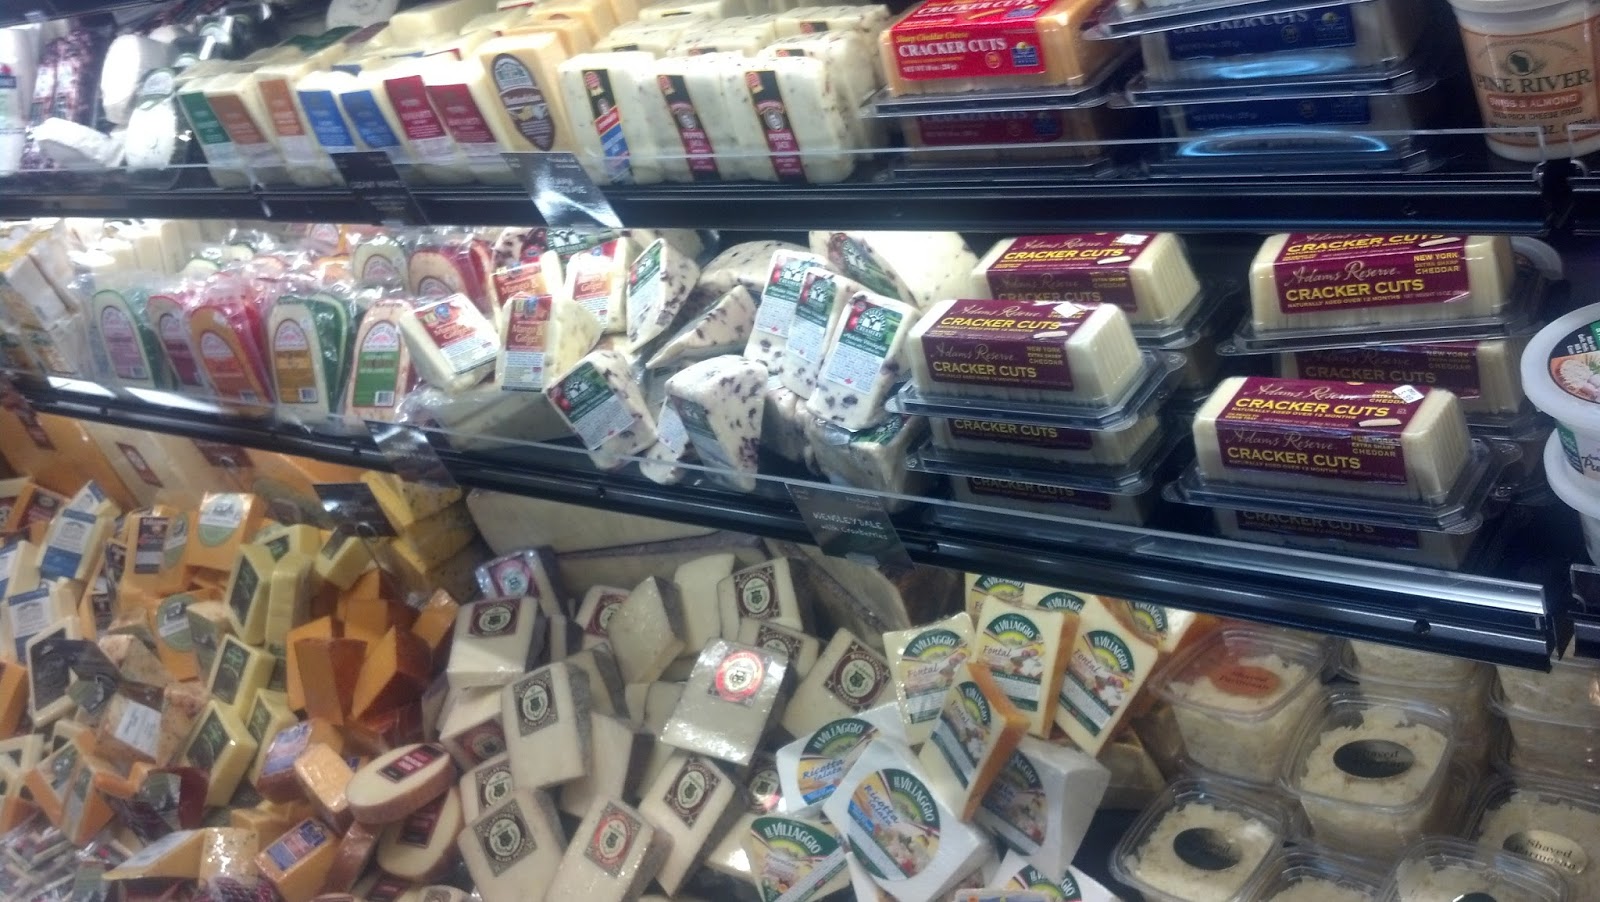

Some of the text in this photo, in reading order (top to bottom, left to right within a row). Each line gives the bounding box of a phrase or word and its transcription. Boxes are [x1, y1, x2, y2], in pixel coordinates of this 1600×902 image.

[899, 38, 1008, 57] CRACKER CUTS
[1521, 69, 1592, 93] RIVER
[1530, 94, 1578, 107] ALMOND
[1004, 249, 1079, 260] CRACKER
[1080, 248, 1126, 257] CUTS
[1288, 237, 1384, 253] CRACKER
[1414, 252, 1458, 262] NEW YORK
[1284, 260, 1400, 286] Adams Reserve
[1415, 266, 1460, 275] CHEDDAR
[1064, 291, 1101, 302] CUTS
[1286, 279, 1425, 302] CRACKER CUTS
[1287, 300, 1323, 308] NATURALLY
[1372, 294, 1400, 302] MONTHS
[952, 305, 1041, 317] Adams Reserve
[512, 324, 536, 334] Mango
[941, 317, 1062, 330] CRACKER CUTS
[514, 333, 542, 346] Ginger
[931, 342, 1014, 362] Adams Reserve
[932, 361, 1037, 378] CRACKER CUTS
[1029, 358, 1063, 366] CHEDDAR
[1305, 366, 1437, 383] CRACKER CUTS
[1247, 383, 1303, 398] Adams
[1235, 398, 1390, 417] CRACKER CUTS
[954, 419, 1058, 438] CRACKER CUTS
[1226, 429, 1333, 450] Adams Reserve
[1227, 447, 1361, 470] CRACKER CUTS
[1352, 448, 1396, 458] CHEDDAR
[972, 477, 1076, 497] CRACKER CUTS
[1243, 510, 1374, 533] CRACKER CUTS
[999, 618, 1035, 639] VILLAGGIO
[915, 635, 956, 653] VILLAGGIO
[983, 645, 1012, 657] Fontal
[1100, 635, 1129, 670] VILLAGGIO
[907, 663, 939, 677] Fontal
[1072, 648, 1102, 673] Fontal
[817, 722, 865, 744] VILLAGGIO
[803, 759, 844, 779] Ricotta
[864, 784, 900, 824] Ricotta
[900, 776, 935, 822] VILLAGGIO
[763, 822, 822, 854] IL VILLAGGIO
[1528, 839, 1573, 858] Shaved
